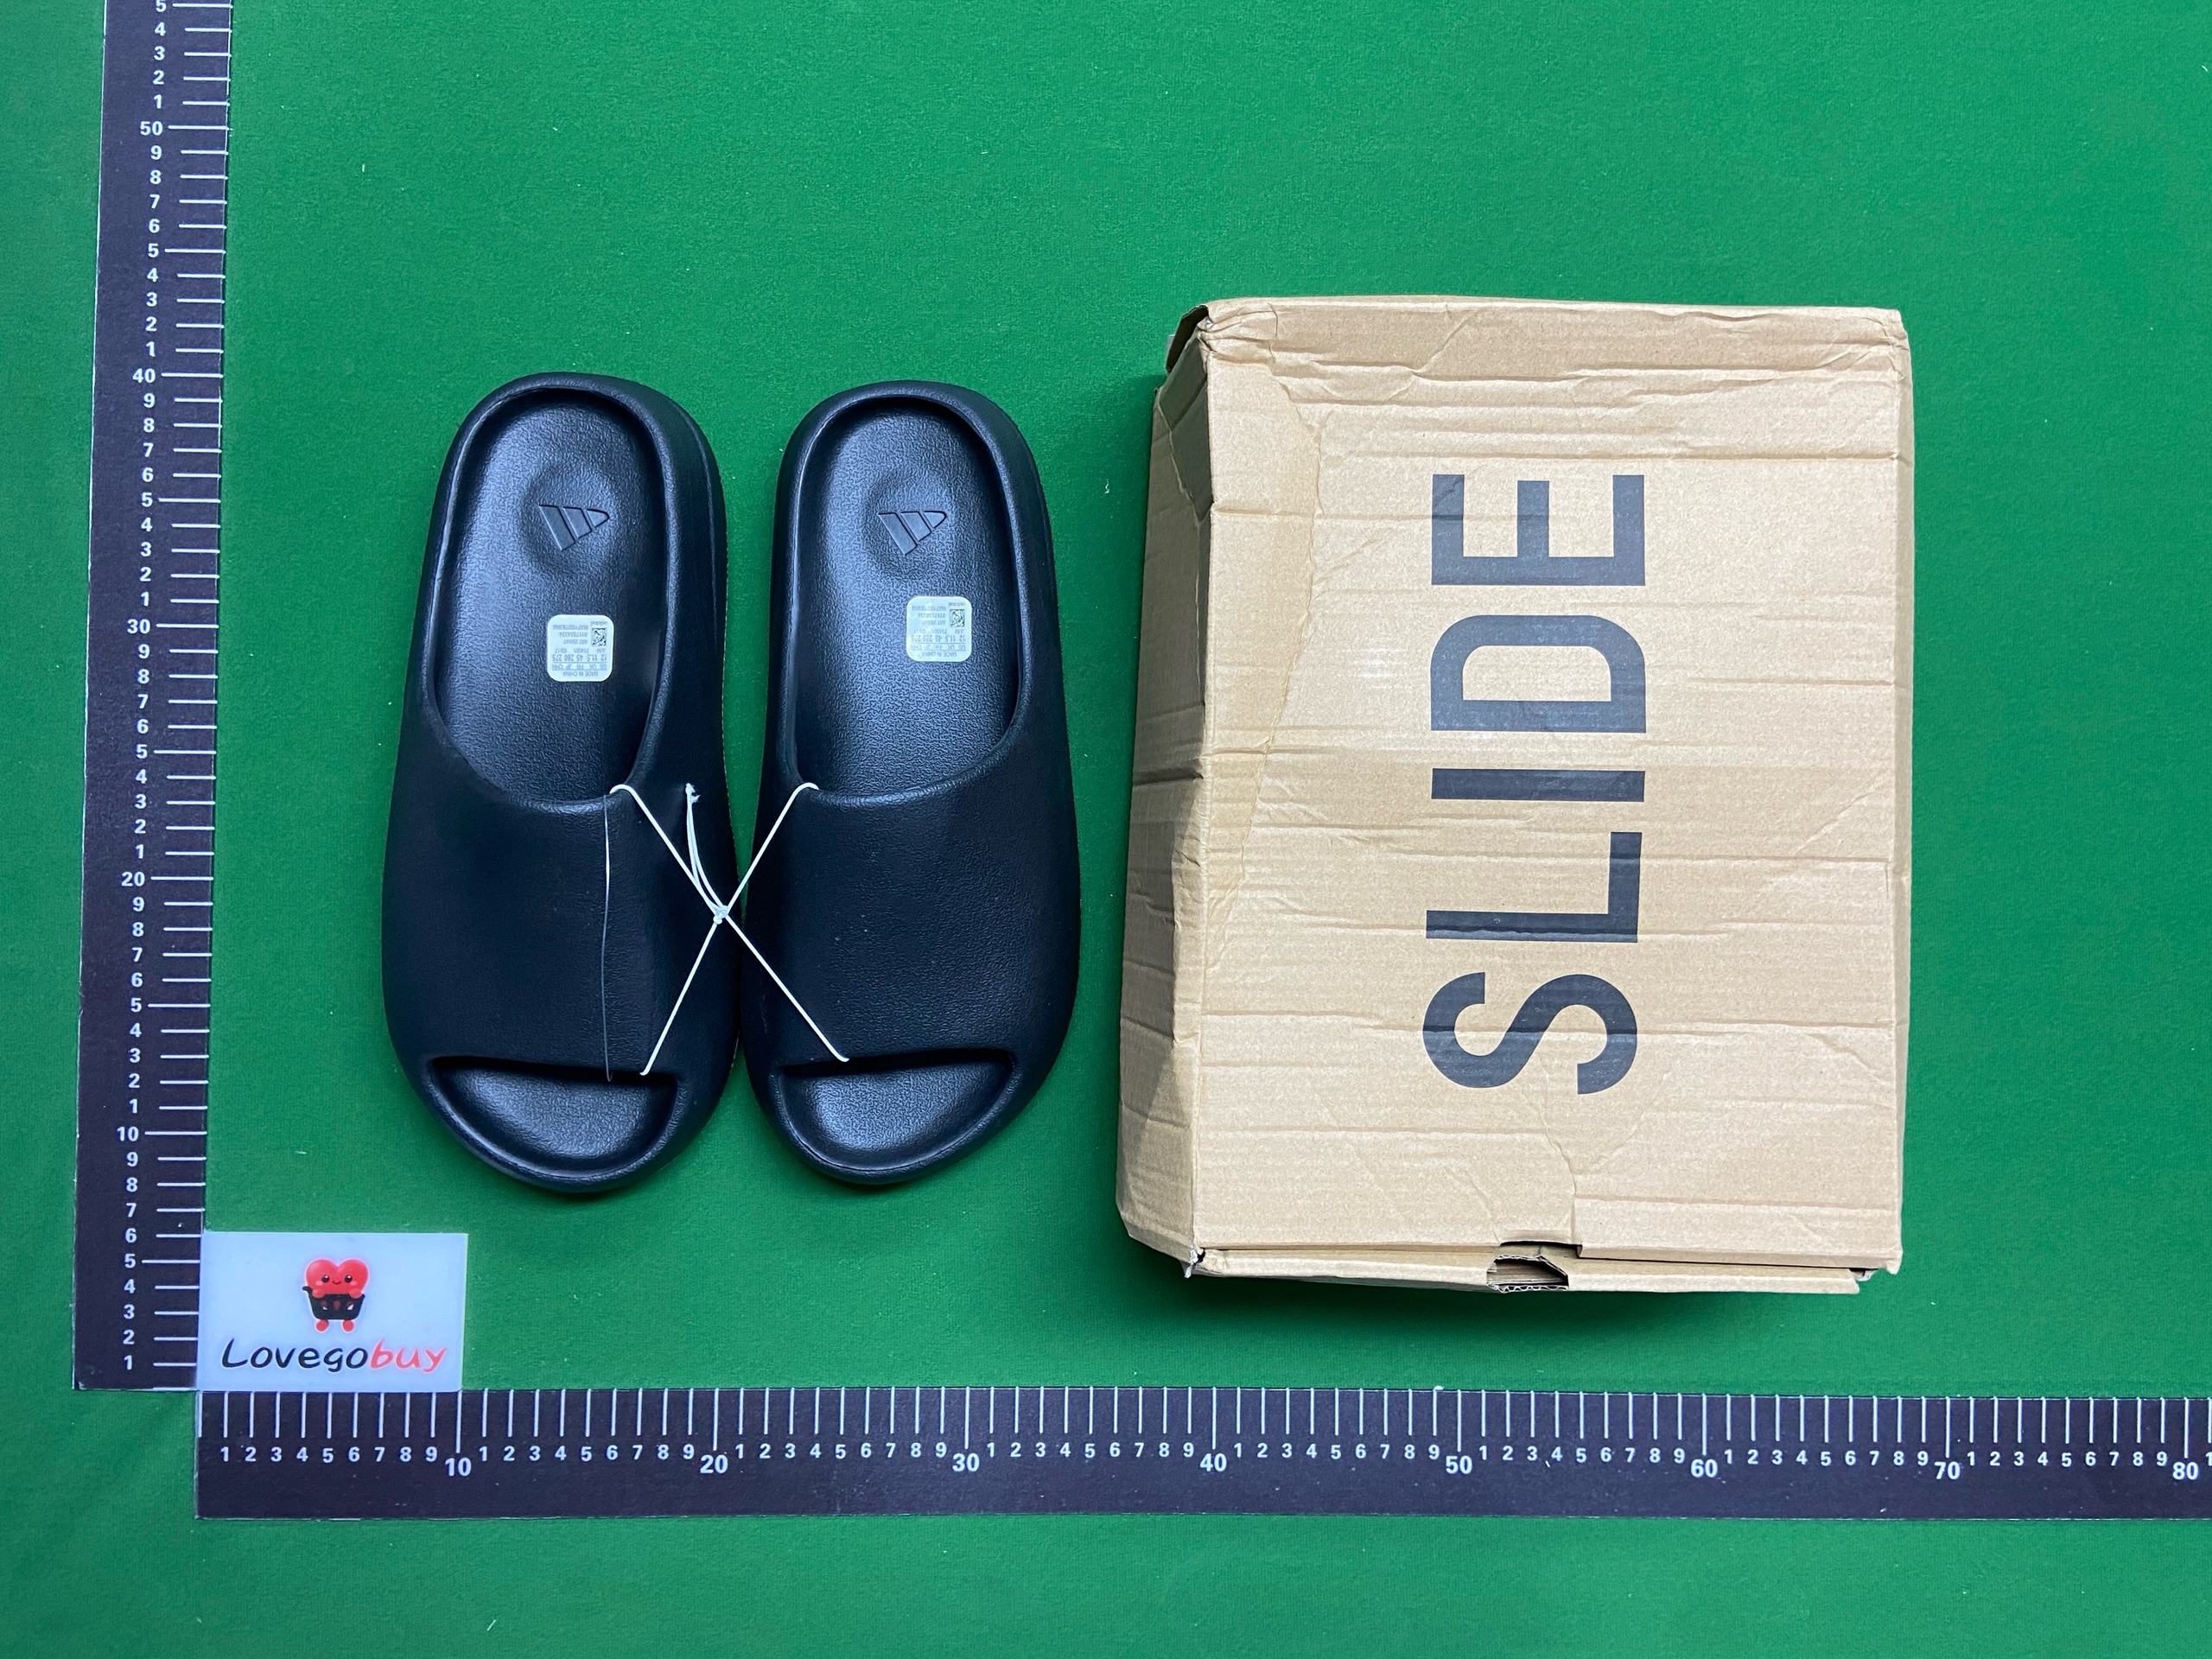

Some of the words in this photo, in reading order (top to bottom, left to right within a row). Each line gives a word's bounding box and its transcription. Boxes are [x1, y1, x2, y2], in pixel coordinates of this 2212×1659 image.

[156, 0, 167, 13] 5
[154, 21, 167, 37] 4
[153, 45, 166, 61] 3
[152, 69, 165, 86] 2
[153, 93, 162, 110] 1
[139, 120, 163, 137] 50
[150, 144, 162, 161] 9
[149, 169, 162, 185] 8
[149, 194, 161, 209] 7
[148, 218, 161, 234] 6
[148, 242, 160, 258] 5
[146, 267, 159, 283] 4
[145, 291, 158, 308] 3
[145, 315, 158, 332] 2
[145, 340, 156, 358] 1
[131, 367, 156, 384] 40
[143, 392, 156, 409] 9
[143, 417, 156, 433] 8
[143, 442, 154, 458] 7
[142, 467, 155, 483] 6
[141, 492, 154, 508] 5
[140, 517, 153, 532] 4
[140, 541, 152, 557] 3
[139, 566, 152, 582] 2
[140, 591, 149, 607] 1
[126, 618, 151, 634] 30
[137, 643, 150, 659] 9
[137, 668, 150, 684] 8
[137, 693, 149, 709] 7
[137, 718, 149, 734] 6
[136, 743, 148, 760] 5
[135, 768, 148, 785] 4
[1422, 474, 1646, 1095] SLIDE
[134, 793, 147, 810] 3
[134, 818, 147, 835] 2
[135, 843, 144, 860] 1
[121, 871, 145, 887] 20
[132, 896, 145, 912] 9
[132, 921, 144, 938] 8
[131, 946, 143, 963] 7
[131, 972, 143, 988] 6
[130, 997, 143, 1013] 5
[130, 1022, 143, 1038] 4
[129, 1047, 141, 1064] 3
[128, 1072, 140, 1089] 2
[129, 1098, 138, 1114] 1
[117, 1126, 139, 1142] 10
[126, 1151, 138, 1167] 9
[126, 1177, 138, 1192] 8
[125, 1202, 137, 1217] 7
[125, 1227, 137, 1243] 6
[124, 1253, 137, 1268] 5
[124, 1278, 136, 1294] 4
[124, 1304, 135, 1319] 3
[123, 1329, 135, 1345] 2
[124, 1355, 132, 1370] 1
[221, 1338, 447, 1372] Lovegobuy
[220, 1446, 229, 1462] 1
[245, 1446, 257, 1462] 2
[270, 1446, 283, 1462] 3
[296, 1446, 308, 1462] 4
[322, 1447, 334, 1464] 5
[348, 1446, 360, 1462] 6
[374, 1446, 385, 1462] 7
[399, 1446, 412, 1462] 8
[425, 1446, 438, 1462] 9
[445, 1457, 472, 1477] 10
[479, 1446, 487, 1462] 1
[503, 1445, 515, 1462] 2
[529, 1445, 541, 1461] 3
[555, 1445, 567, 1461] 4
[581, 1446, 593, 1462] 5
[606, 1445, 619, 1460] 6
[632, 1444, 643, 1460] 7
[657, 1444, 670, 1460] 8
[683, 1443, 695, 1460] 9
[700, 1454, 728, 1474] 20
[734, 1443, 744, 1459] 1
[759, 1443, 771, 1459] 2
[785, 1442, 796, 1459] 3
[810, 1443, 822, 1459] 4
[835, 1443, 847, 1459] 5
[860, 1442, 872, 1459] 6
[885, 1442, 896, 1459] 7
[910, 1442, 922, 1459] 8
[935, 1441, 947, 1459] 9
[951, 1452, 980, 1472] 30
[987, 1441, 995, 1459] 1
[1010, 1441, 1021, 1458] 2
[1034, 1441, 1046, 1458] 3
[1059, 1441, 1071, 1458] 4
[1084, 1443, 1096, 1459] 5
[1109, 1441, 1121, 1458] 6
[1134, 1441, 1145, 1458] 7
[1159, 1441, 1170, 1458] 8
[1183, 1441, 1194, 1458] 9
[1199, 1452, 1227, 1472] 40
[1234, 1442, 1242, 1459] 1
[1256, 1442, 1268, 1459] 2
[1281, 1442, 1293, 1459] 3
[1306, 1443, 1318, 1459] 4
[1331, 1444, 1342, 1460] 5
[1355, 1443, 1367, 1459] 6
[1380, 1443, 1390, 1459] 7
[1404, 1444, 1415, 1460] 8
[1427, 1444, 1440, 1460] 9
[1446, 1455, 1473, 1475] 50
[1478, 1445, 1487, 1461] 1
[1502, 1445, 1514, 1461] 2
[1527, 1446, 1538, 1461] 3
[1550, 1446, 1563, 1462] 4
[1575, 1447, 1587, 1464] 5
[1600, 1446, 1612, 1463] 6
[1624, 1446, 1636, 1463] 7
[1649, 1447, 1661, 1464] 8
[1673, 1447, 1686, 1464] 9
[1690, 1459, 1719, 1478] 60
[1724, 1448, 1732, 1465] 1
[1747, 1448, 1759, 1465] 2
[1771, 1449, 1783, 1465] 3
[1796, 1449, 1808, 1465] 4
[1820, 1451, 1832, 1466] 5
[1845, 1450, 1857, 1466] 6
[1869, 1450, 1879, 1466] 7
[1893, 1450, 1904, 1466] 8
[1916, 1450, 1929, 1466] 9
[1934, 1460, 1961, 1480] 70
[1967, 1451, 1975, 1466] 1
[1989, 1451, 2001, 1466] 2
[2013, 1451, 2024, 1466] 3
[2037, 1451, 2049, 1466] 4
[2061, 1452, 2072, 1467] 5
[2085, 1451, 2096, 1466] 6
[2108, 1451, 2120, 1466] 7
[2133, 1451, 2144, 1467] 8
[2156, 1451, 2168, 1467] 9
[2172, 1461, 2199, 1480] 80
[2205, 1452, 2212, 1466] 1
